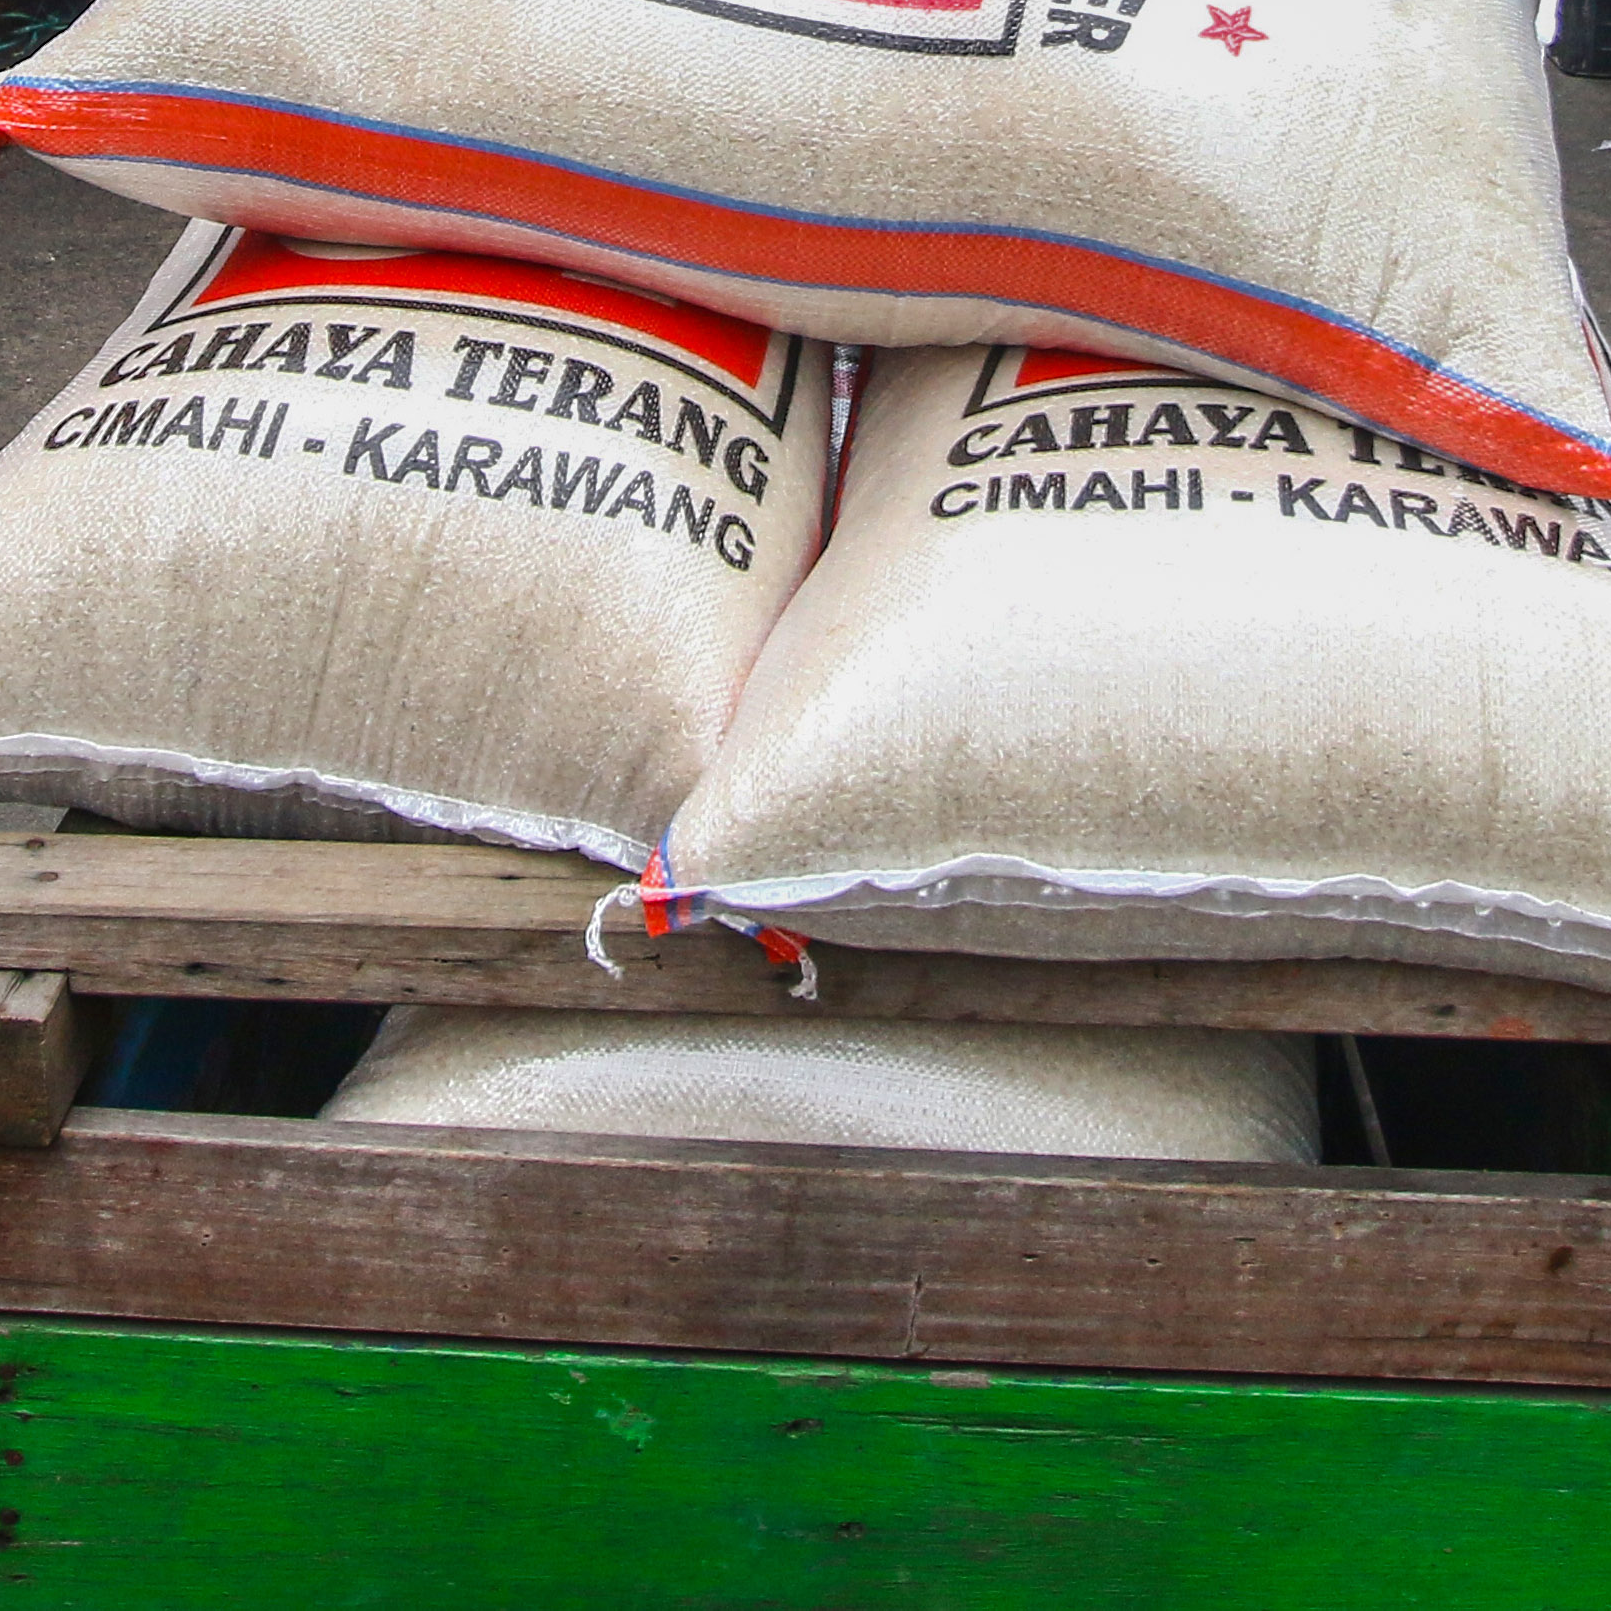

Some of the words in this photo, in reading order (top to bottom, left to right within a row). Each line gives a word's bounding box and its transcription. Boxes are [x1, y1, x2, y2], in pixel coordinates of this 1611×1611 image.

[99, 321, 415, 389] CAHAYA
[444, 335, 770, 506] TERANG
[946, 402, 1313, 467] CAHAYA
[43, 396, 290, 459] CIMAHI
[343, 417, 757, 572] KARAWANG
[931, 468, 1203, 519] CIMAHI
